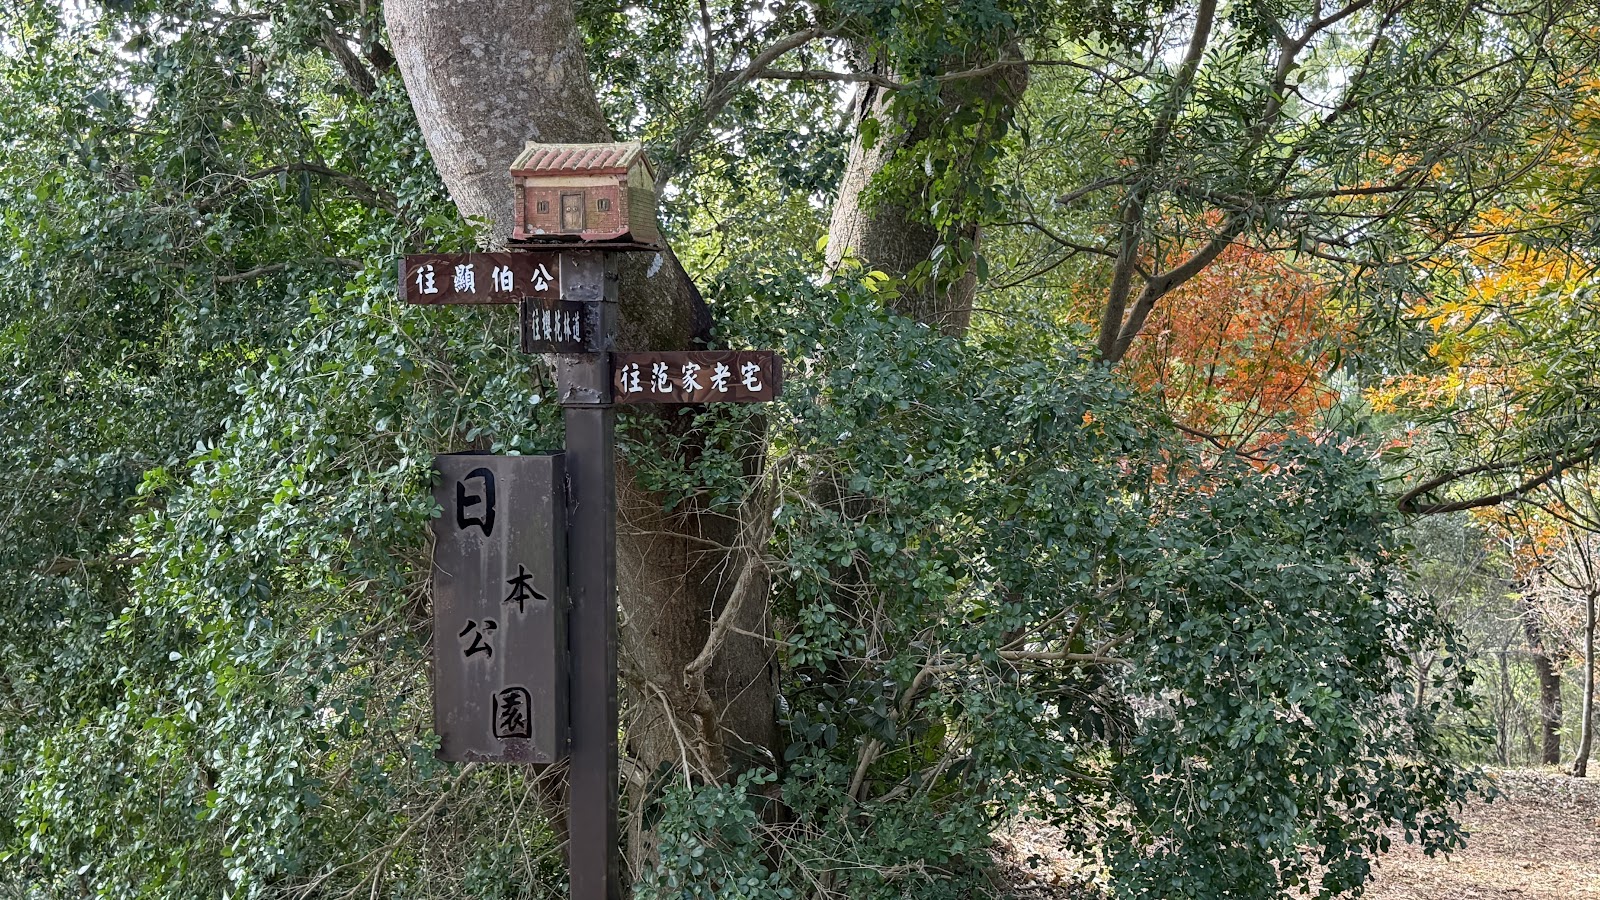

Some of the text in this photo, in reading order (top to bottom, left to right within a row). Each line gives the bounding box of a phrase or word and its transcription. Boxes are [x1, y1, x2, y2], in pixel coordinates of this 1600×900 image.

[415, 262, 555, 295] 往顯伯公
[532, 309, 581, 342] 往櫻花林道
[620, 361, 763, 394] 往范家老宅
[457, 467, 548, 739] 日本公園
